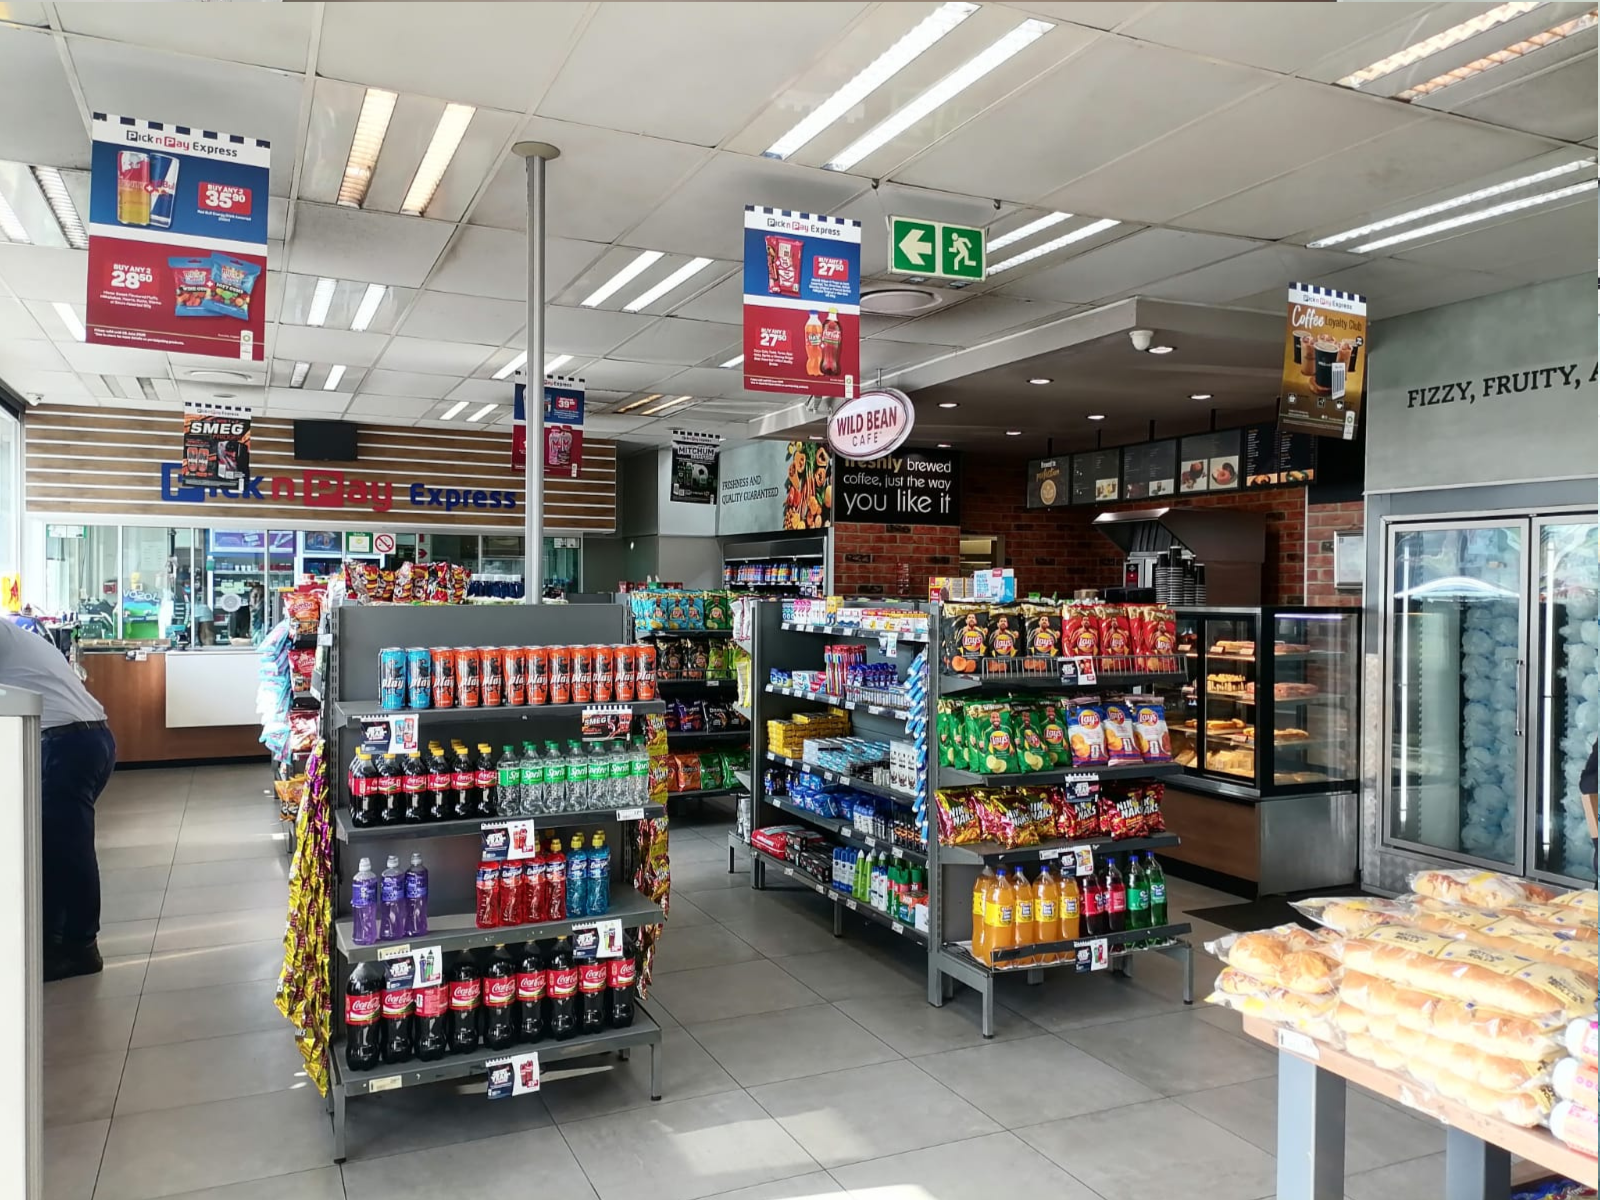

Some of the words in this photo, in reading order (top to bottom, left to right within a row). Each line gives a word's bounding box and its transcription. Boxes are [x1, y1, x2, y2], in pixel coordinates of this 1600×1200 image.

[126, 130, 154, 143] Pick
[155, 135, 162, 145] n
[164, 136, 190, 151] Pay
[192, 141, 238, 158] Express
[207, 184, 222, 192] BUY
[222, 186, 238, 195] ANY
[767, 217, 786, 227] Pick
[791, 221, 809, 233] Pay
[810, 223, 841, 236] Express
[113, 263, 129, 272] BUY
[129, 265, 145, 274] ANY
[1332, 300, 1352, 310] Express
[1292, 305, 1325, 329] Coffee
[1325, 316, 1347, 331] Loyalty
[1348, 318, 1362, 332] Club
[1407, 381, 1475, 408] FIZZY,
[1482, 364, 1581, 397] FRUITY,
[837, 417, 864, 436] WILD
[866, 405, 898, 431] BEAN
[190, 422, 244, 435] SMEG
[851, 431, 878, 447] CAFE
[678, 446, 715, 456] MITCHUM
[907, 458, 952, 473] brewed
[843, 472, 882, 487] coffee,
[885, 474, 904, 489] just
[907, 475, 926, 489] the
[928, 478, 952, 491] way
[271, 475, 296, 501] n
[303, 470, 393, 512] Pay
[409, 483, 517, 512] Express
[843, 492, 887, 515] you
[897, 488, 932, 513] like
[940, 492, 951, 514] it
[584, 716, 607, 727] SMEG
[949, 805, 964, 816] NIK
[1116, 799, 1133, 811] NIK
[1121, 805, 1142, 819] NAK
[953, 812, 974, 826] NAKS
[453, 984, 481, 997] Coca-Cola
[352, 997, 381, 1012] Coca-Cola
[384, 992, 414, 1005] Coca-Cola
